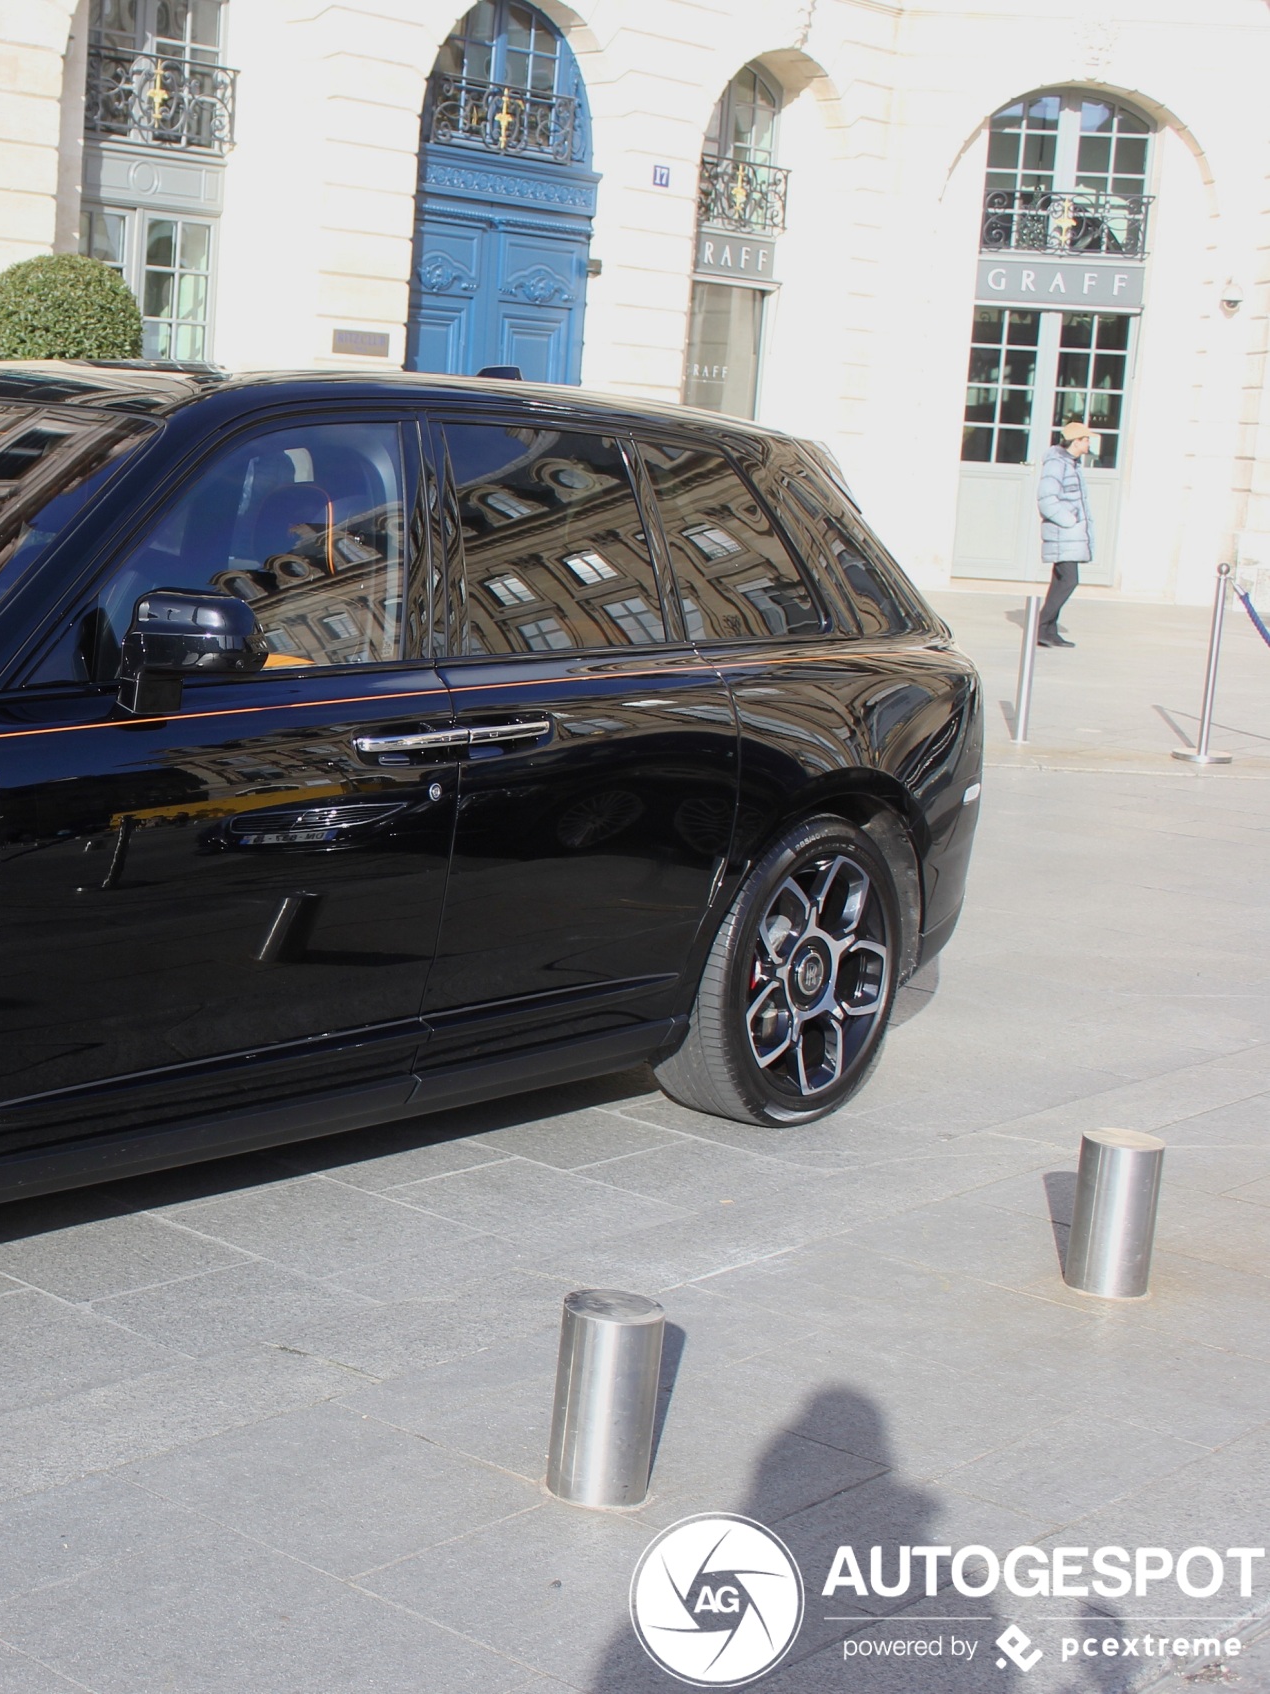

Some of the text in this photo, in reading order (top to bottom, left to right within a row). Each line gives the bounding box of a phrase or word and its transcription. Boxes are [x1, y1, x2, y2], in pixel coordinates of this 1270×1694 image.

[654, 166, 668, 185] 17
[703, 241, 768, 272] RAFF
[987, 268, 1128, 296] GRAFF
